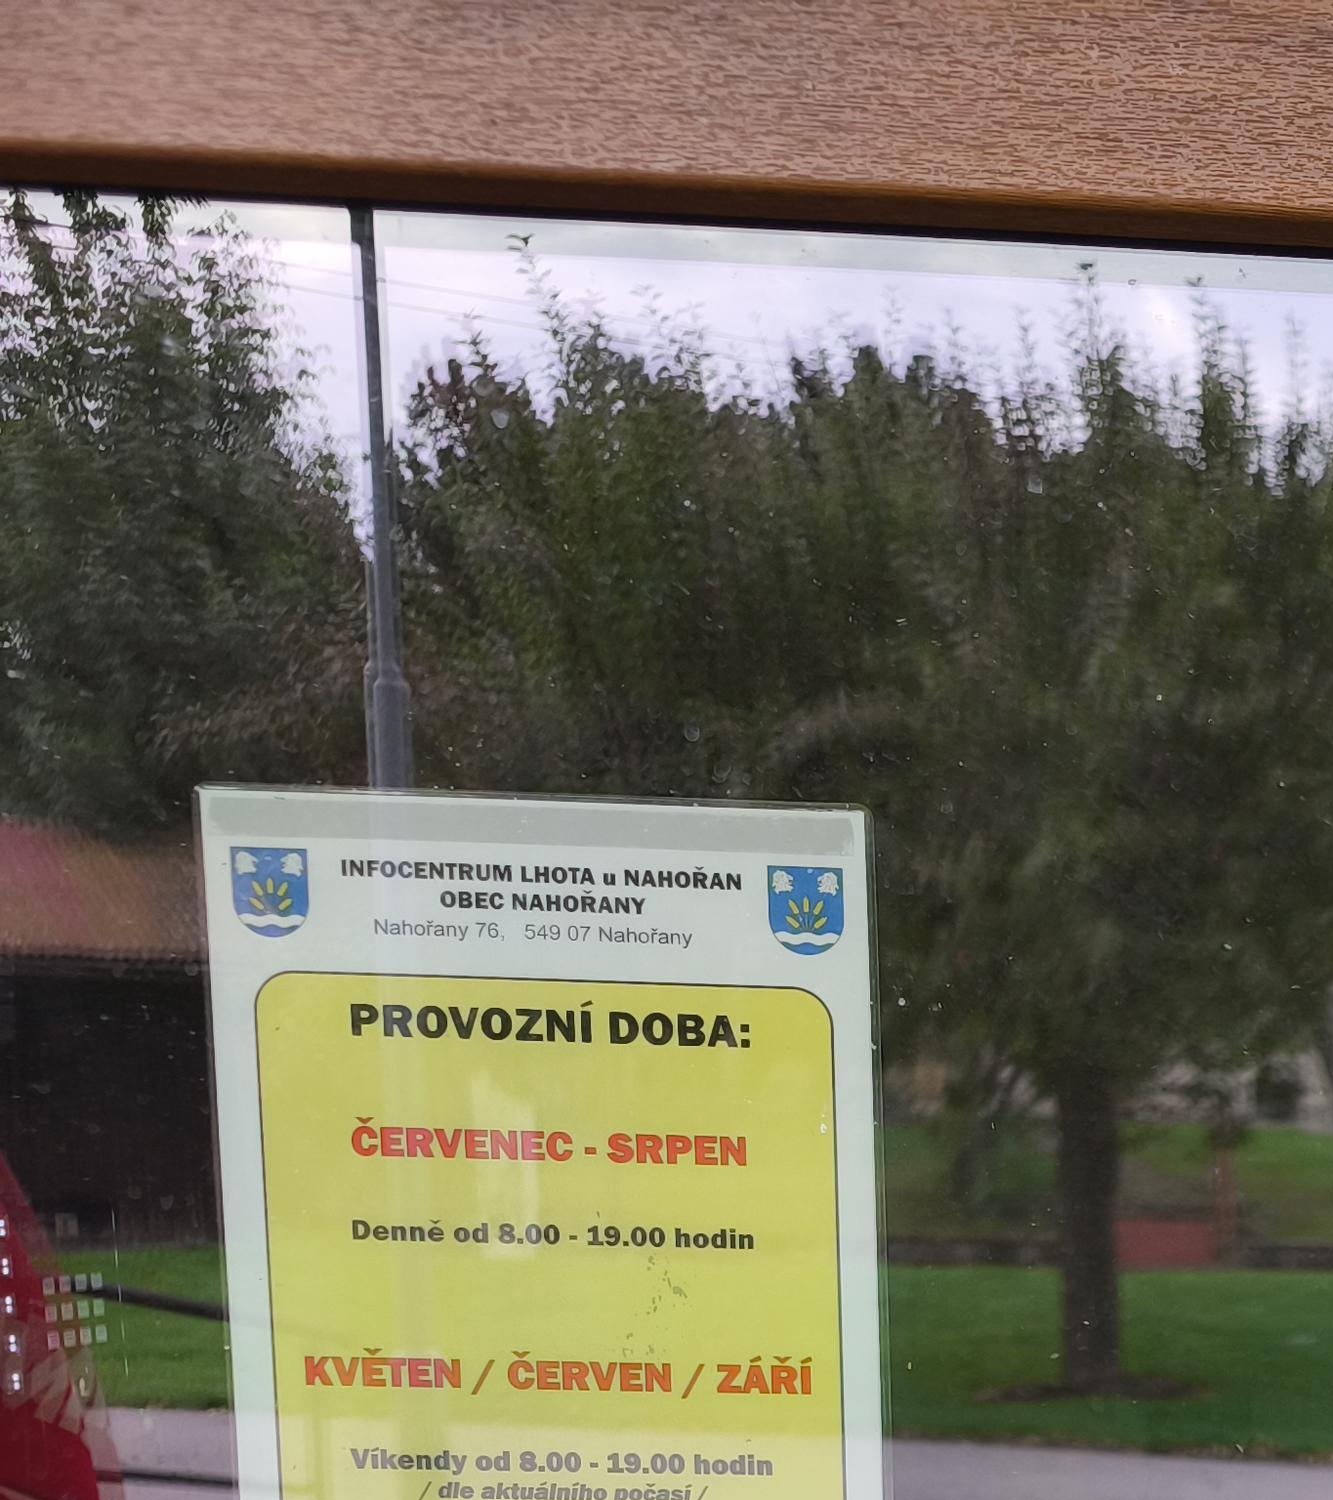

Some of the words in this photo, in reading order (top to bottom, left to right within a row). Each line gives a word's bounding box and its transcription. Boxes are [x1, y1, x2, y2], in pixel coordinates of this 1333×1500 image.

[341, 858, 513, 884] INFOCENTRUM
[521, 864, 595, 886] LHOTA
[603, 872, 616, 886] u
[624, 864, 742, 891] NAHOŘAN
[440, 890, 505, 910] OBEC
[512, 890, 646, 915] NAHOŘANY
[373, 918, 469, 941] Nahořany
[475, 922, 506, 942] 76,
[524, 924, 560, 942] 549
[568, 925, 591, 942] 07
[598, 926, 692, 949] Nahořany
[350, 1001, 593, 1043] PROVOZNÍ
[609, 1011, 751, 1048] DOBA:
[351, 1116, 573, 1161] ČERVENEC
[607, 1133, 747, 1166] SRPEN
[352, 1220, 444, 1244] Denně
[453, 1224, 489, 1244] od
[499, 1224, 561, 1246] 8.00
[587, 1225, 665, 1248] 19.00
[674, 1226, 755, 1251] hodin
[304, 1348, 461, 1388] KVĚTEN
[471, 1360, 494, 1395] /
[507, 1351, 672, 1392] ČERVEN
[682, 1364, 705, 1399] /
[716, 1356, 813, 1395] ZÁŘÍ
[350, 1447, 467, 1475] Víkendy
[475, 1451, 511, 1472] od
[519, 1451, 582, 1473] 8.00
[606, 1453, 685, 1474] 19.00
[694, 1454, 773, 1476] hodin
[418, 1481, 431, 1500] /
[438, 1481, 475, 1500] dle
